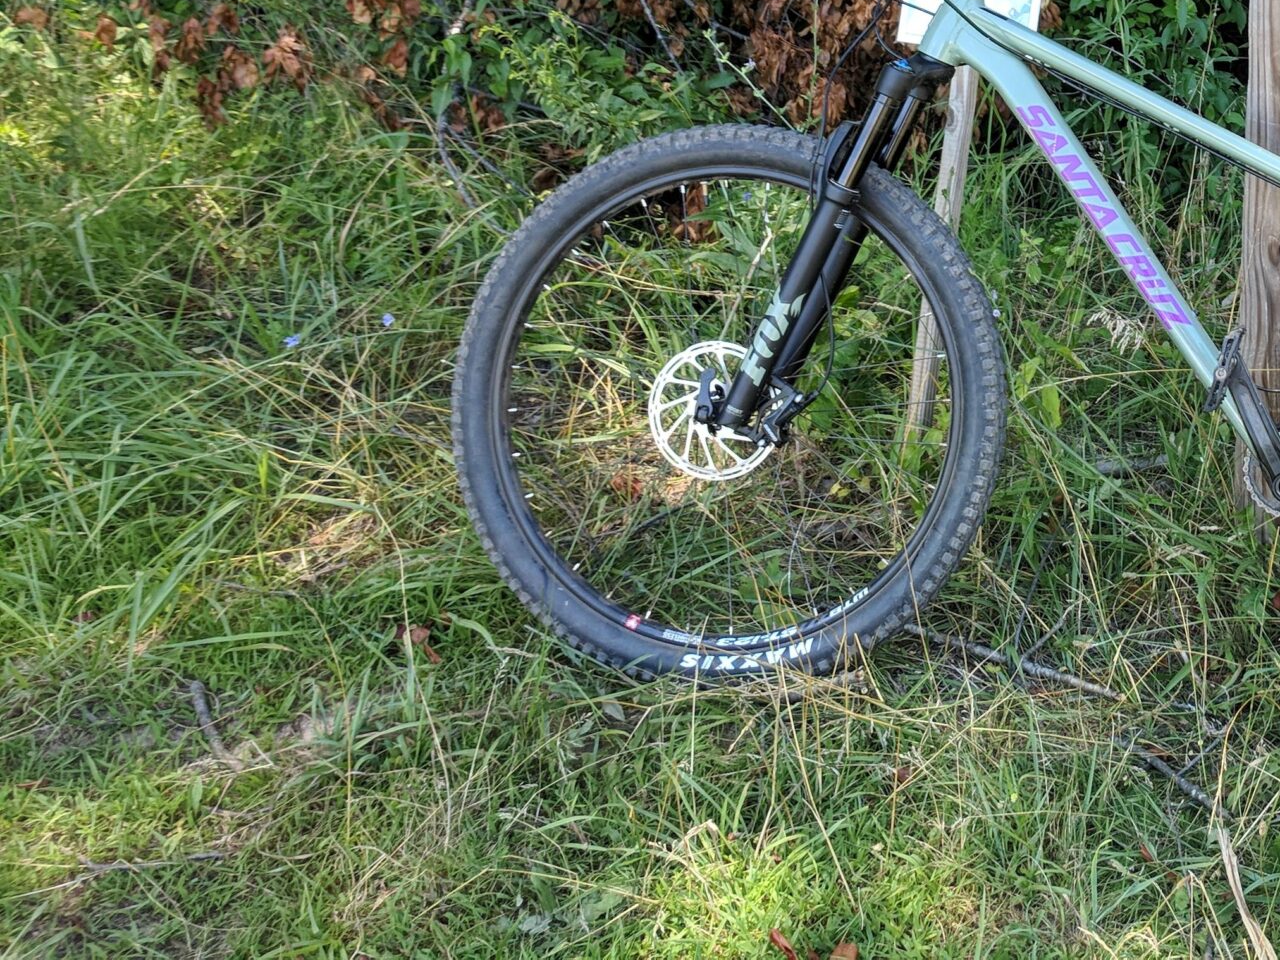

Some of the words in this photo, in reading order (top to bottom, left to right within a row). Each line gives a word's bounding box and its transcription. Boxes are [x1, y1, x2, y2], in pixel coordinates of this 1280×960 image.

[1015, 105, 1120, 231] SANTA
[1105, 233, 1193, 331] CRUZ
[740, 285, 807, 387] FOX
[680, 637, 814, 670] MAXXIS
